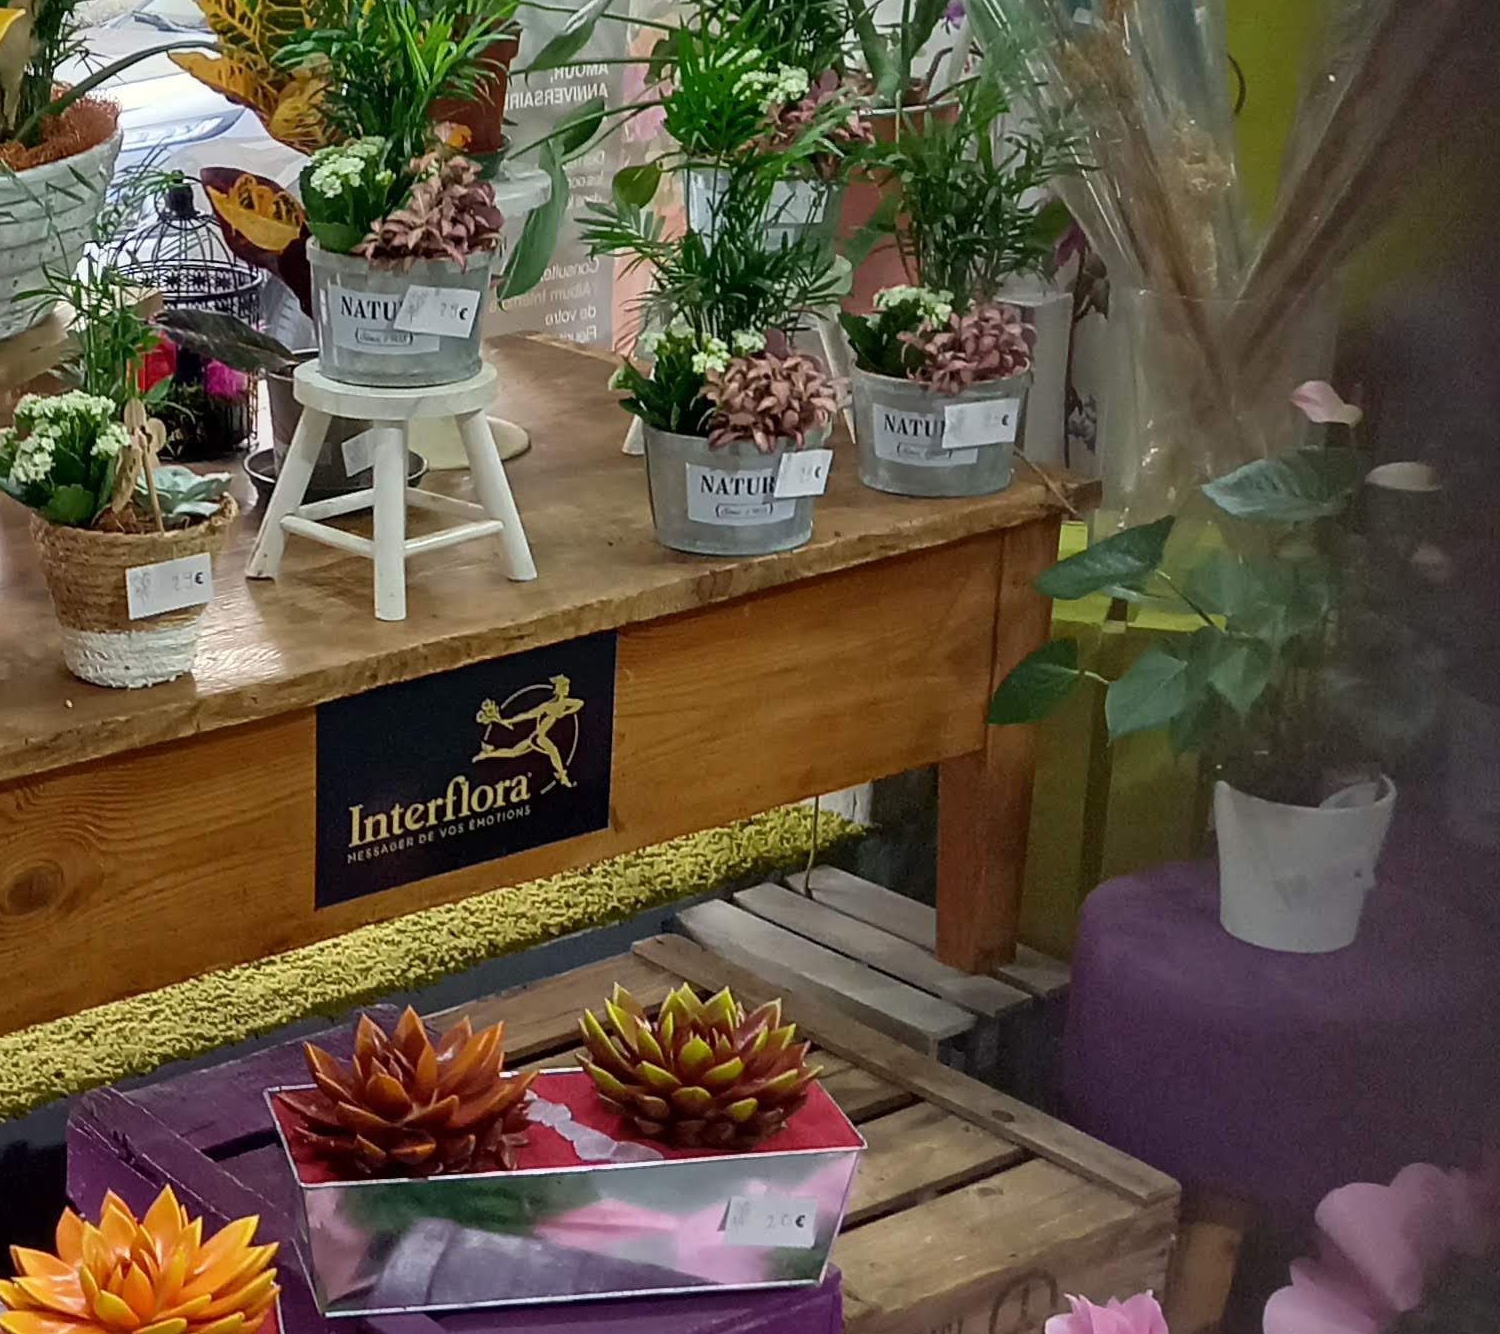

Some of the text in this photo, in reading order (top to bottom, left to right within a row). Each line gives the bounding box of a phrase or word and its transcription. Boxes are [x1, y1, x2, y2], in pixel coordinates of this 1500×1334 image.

[348, 774, 532, 848] Interflora
[418, 830, 435, 844] DE
[439, 822, 464, 839] VOS
